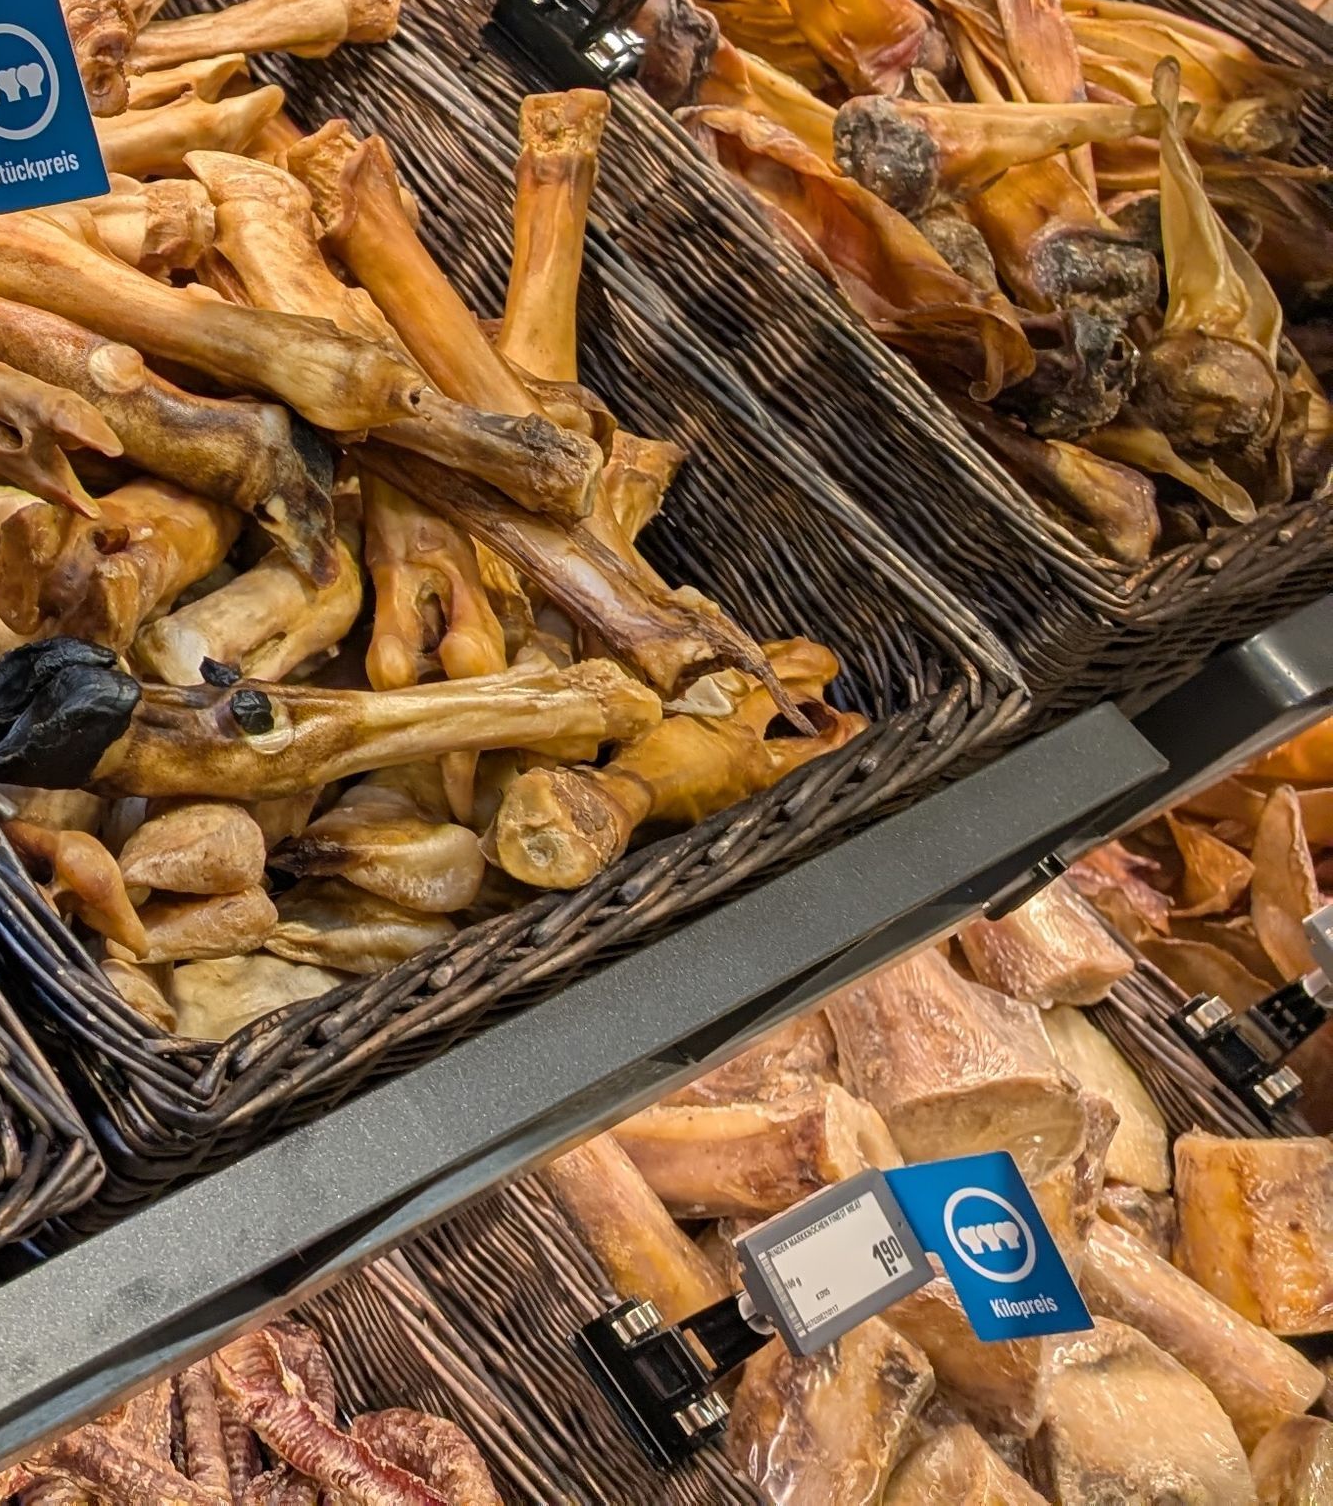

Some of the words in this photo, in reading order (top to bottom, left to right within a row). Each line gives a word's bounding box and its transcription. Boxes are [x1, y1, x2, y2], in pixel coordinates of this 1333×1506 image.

[845, 1199, 862, 1215] MEAT
[872, 1235, 903, 1277] 1.90
[989, 1293, 1059, 1321] Kilopreis
